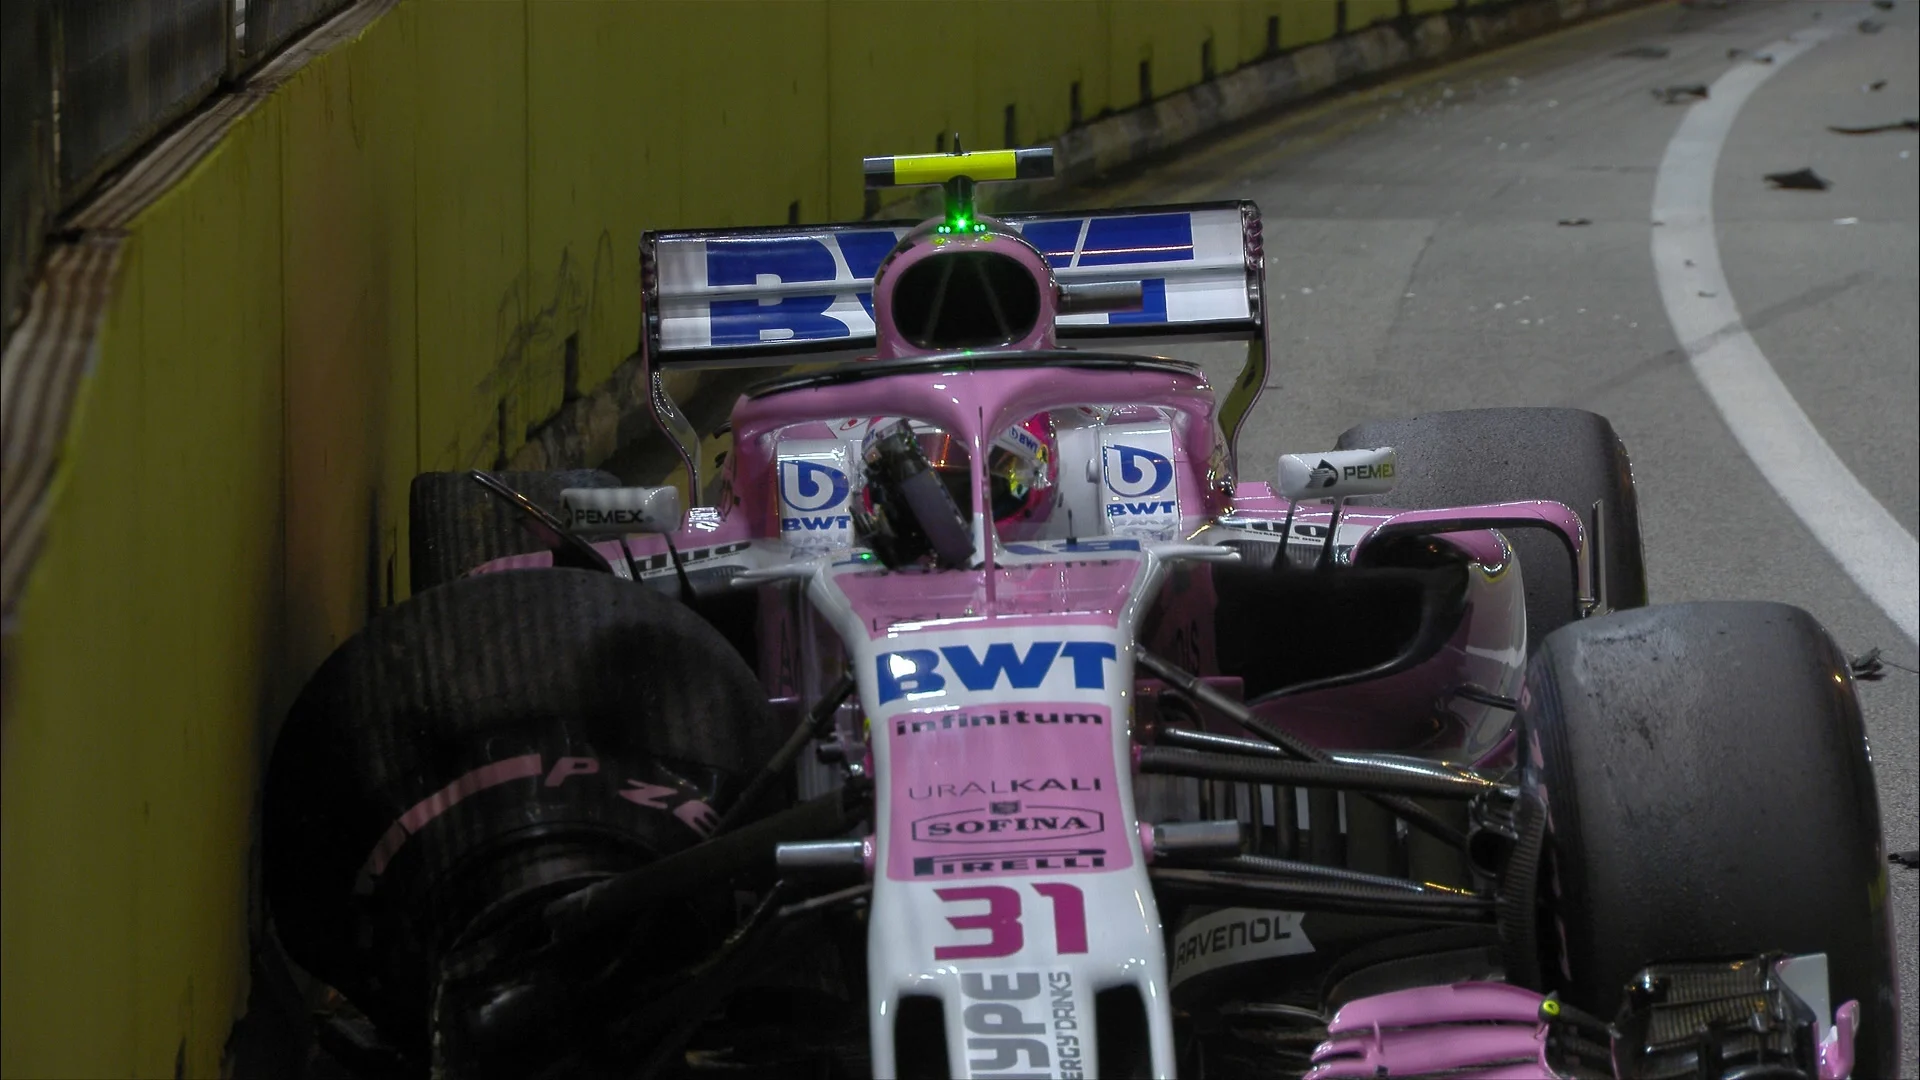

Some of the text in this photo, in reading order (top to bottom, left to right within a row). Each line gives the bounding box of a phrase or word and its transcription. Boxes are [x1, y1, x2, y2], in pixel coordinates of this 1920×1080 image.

[575, 509, 643, 524] PEMEX
[1105, 500, 1176, 517] BWT
[781, 515, 851, 531] BWT
[875, 641, 1116, 706] BWT
[896, 710, 1103, 735] infinitum
[543, 756, 600, 788] P
[908, 777, 1102, 800] URALKALI
[927, 816, 1091, 837] SOFINA
[913, 848, 1107, 877] PIRELLI
[932, 882, 1089, 960] 31
[1176, 915, 1292, 969] RAVENOL
[1047, 971, 1078, 1031] DRINKS
